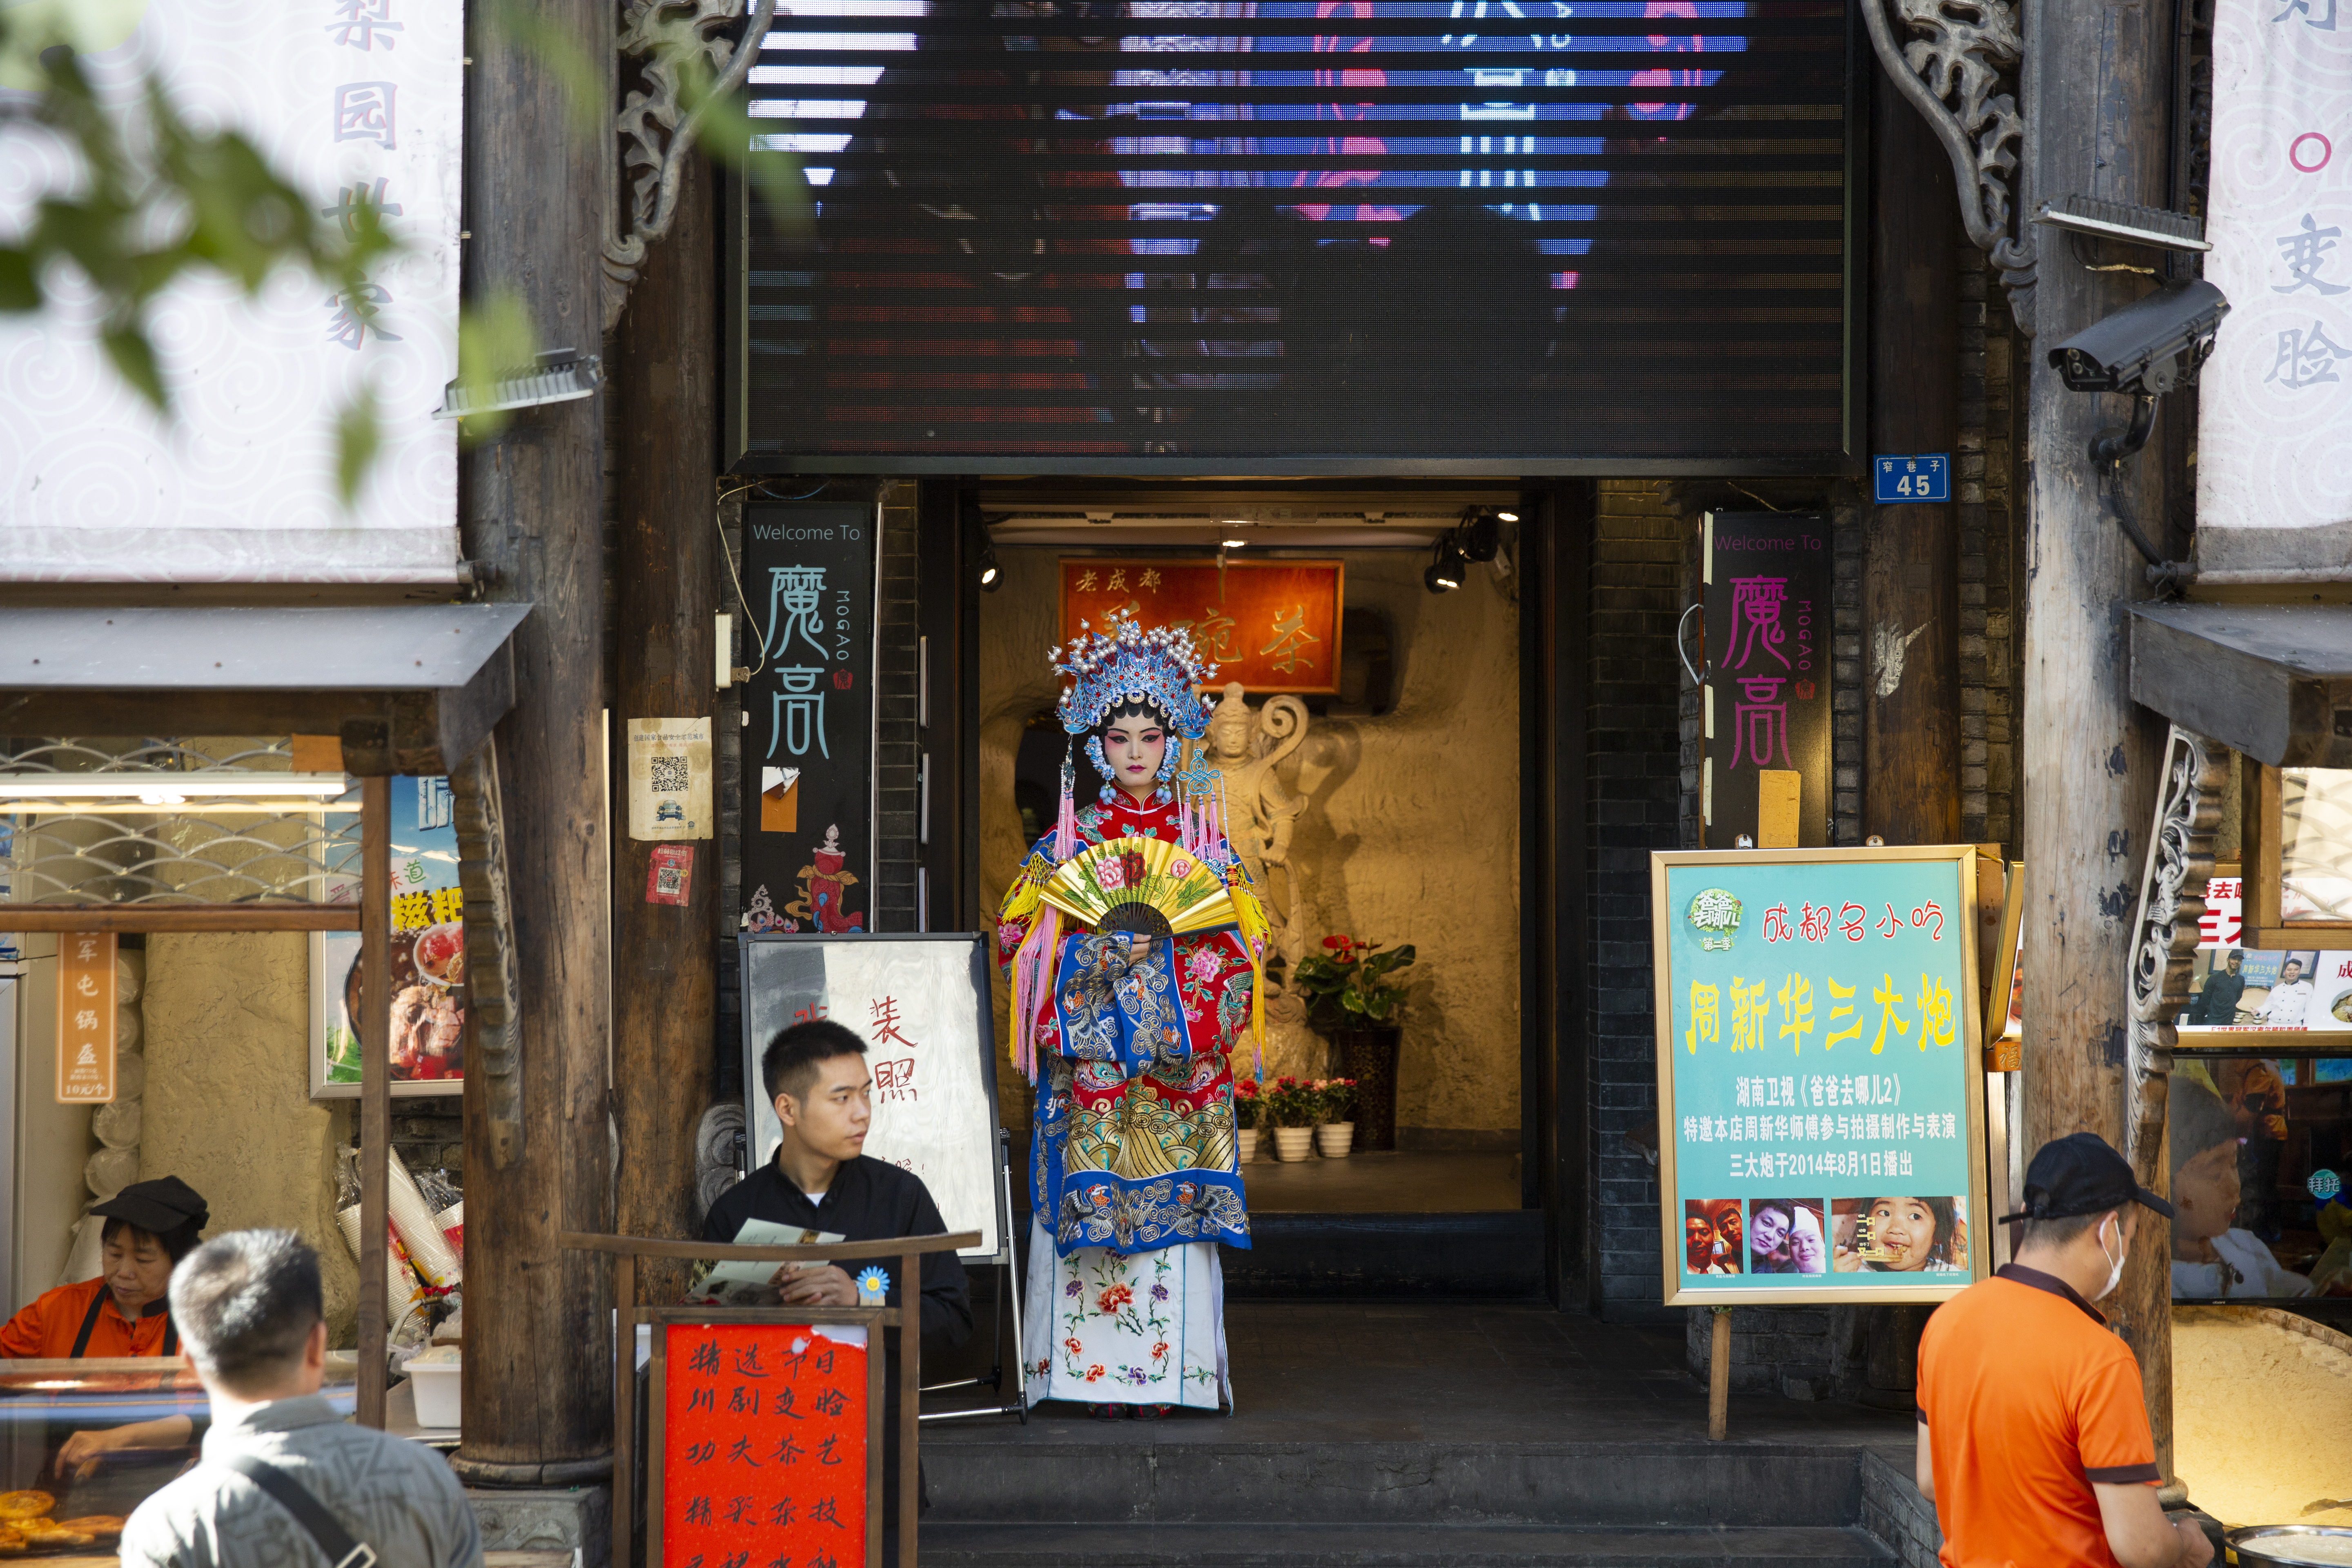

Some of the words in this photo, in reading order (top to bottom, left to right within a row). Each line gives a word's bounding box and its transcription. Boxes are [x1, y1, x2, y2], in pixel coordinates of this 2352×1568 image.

[1883, 460, 1940, 473] 窄巷子
[1897, 475, 1930, 496] 45
[753, 524, 833, 540] Welcome
[840, 525, 860, 540] To
[1715, 535, 1795, 551] Welcome
[1801, 535, 1821, 550] To
[1076, 568, 1162, 594] 老成都
[836, 590, 850, 661] MOGAO
[1797, 601, 1813, 671] MOGAO
[760, 564, 829, 760] 魔高
[1721, 574, 1793, 770] 魔高
[634, 733, 704, 742] 创建国家食品安全示范城市
[391, 887, 464, 931] 糍粑
[1763, 900, 1945, 944] 成都名小吃
[1703, 937, 1731, 951] 第二季
[74, 933, 99, 1065] 军屯锅盔
[1685, 972, 1956, 1057] 周新华三大炮
[1998, 1046, 2021, 1069] 福
[1736, 1073, 1902, 1107] 湖南卫视《爸爸去哪儿2》
[1684, 1113, 1956, 1143] 特邀本店周新华师傅参与拍摄制作与表演
[1730, 1150, 1913, 1178] 三大炮于2014年8月1日播出
[2308, 1177, 2339, 1192] 拜托
[1857, 1247, 1885, 1257] 又一口
[688, 1338, 834, 1381] 精选节目
[687, 1386, 853, 1419] 川剧变脸
[685, 1433, 843, 1467] 功夫茶艺
[684, 1495, 847, 1529] 精彩杂技
